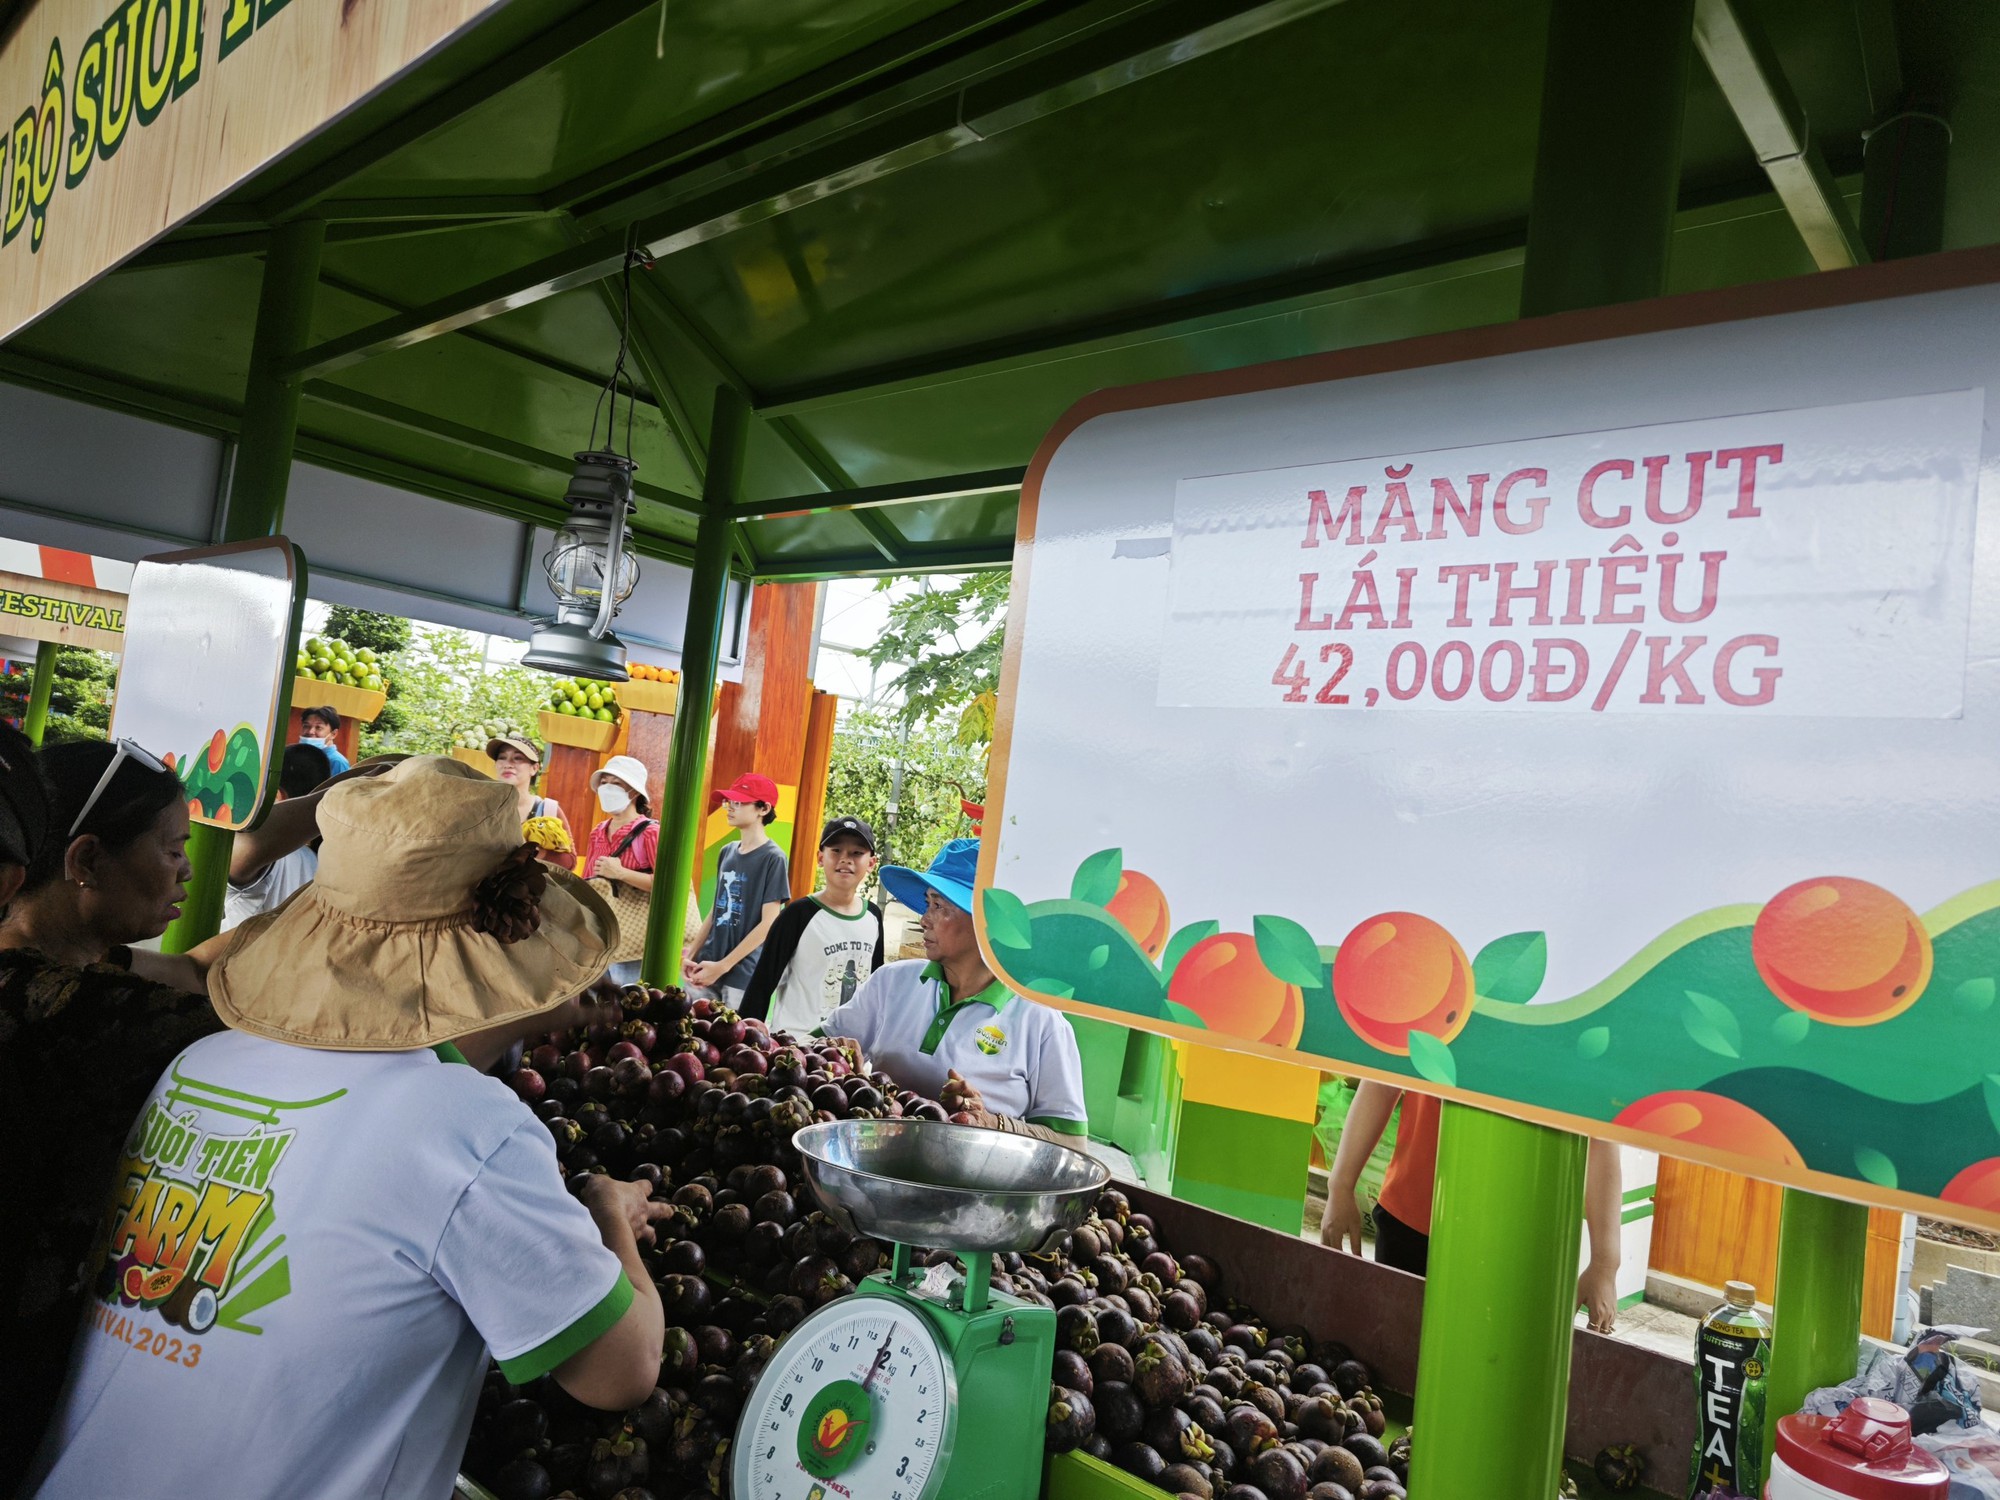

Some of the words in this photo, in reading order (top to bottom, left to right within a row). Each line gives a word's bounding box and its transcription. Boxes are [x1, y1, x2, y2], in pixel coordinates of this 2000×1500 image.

[1300, 462, 1550, 549] MĂNG
[1577, 444, 1784, 548] CỤT
[1294, 549, 1417, 631] LÁI
[1438, 533, 1728, 627] THIÊU
[1271, 629, 1783, 713] 42,000Đ/KG
[824, 941, 848, 957] COME
[850, 940, 862, 951] TO
[128, 1098, 199, 1171] SUỐI
[194, 1125, 295, 1192] TIÊN
[867, 1330, 878, 1341] 11,5
[1731, 1327, 1745, 1335] TEA
[847, 1335, 860, 1350] 11
[811, 1357, 824, 1372] 10
[780, 1392, 793, 1412] 9
[916, 1409, 927, 1424] 2
[914, 1438, 925, 1448] 2,5
[766, 1446, 776, 1460] 8
[895, 1456, 910, 1477] 3
